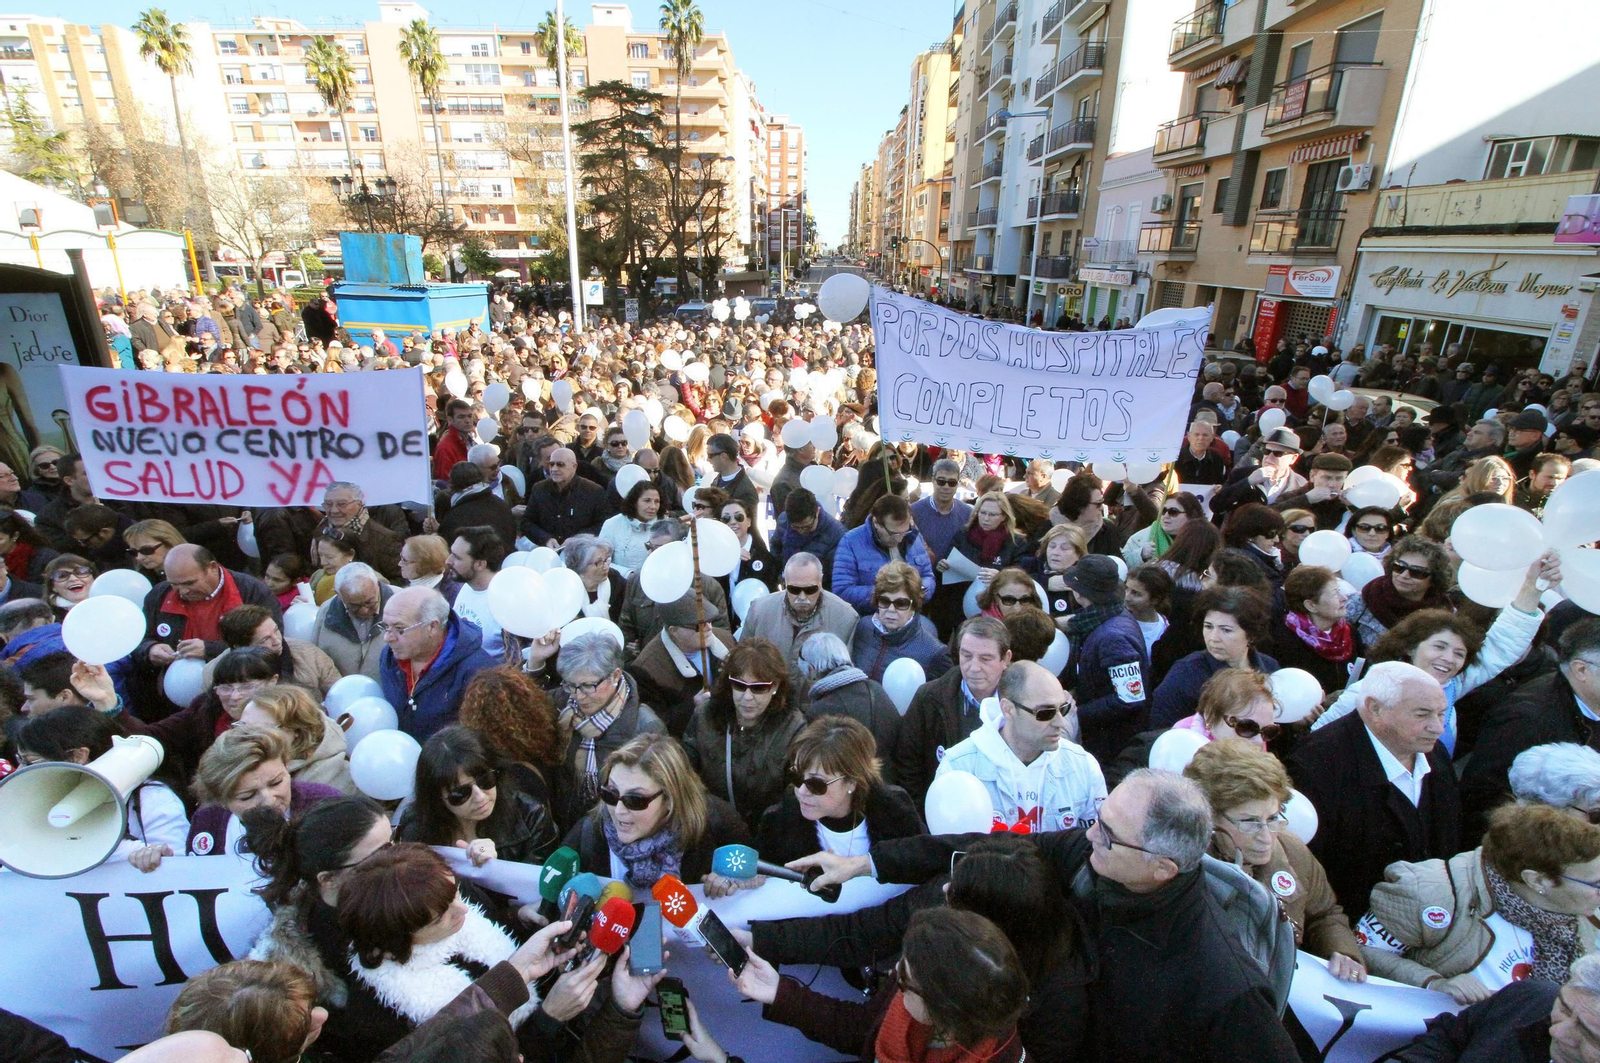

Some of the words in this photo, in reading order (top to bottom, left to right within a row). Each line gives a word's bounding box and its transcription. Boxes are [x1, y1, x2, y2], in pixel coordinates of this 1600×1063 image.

[1058, 287, 1082, 296] ORO
[1515, 272, 1574, 299] Moguer
[8, 305, 49, 323] Dior
[876, 302, 939, 358] POR
[940, 317, 1001, 362] DOS
[893, 372, 1134, 442] COMPLETOS
[216, 428, 365, 460] CENTRO
[377, 430, 424, 460] DE
[104, 459, 245, 501] SALUD
[268, 459, 336, 505] YA
[611, 922, 629, 938] rne
